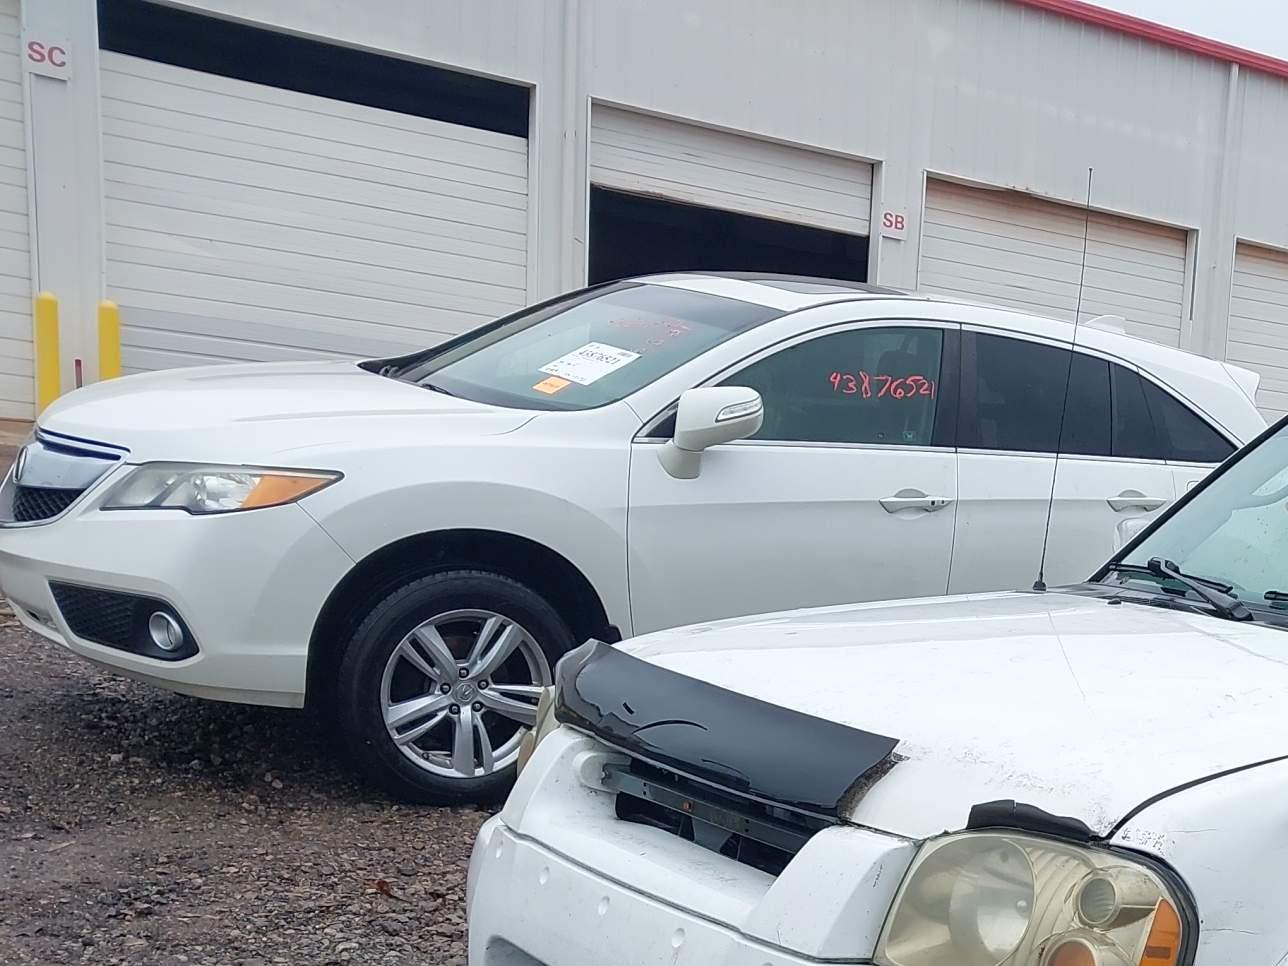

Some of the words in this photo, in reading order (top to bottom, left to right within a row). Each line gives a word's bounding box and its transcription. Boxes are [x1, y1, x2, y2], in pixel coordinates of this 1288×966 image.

[27, 41, 66, 67] SC
[882, 212, 905, 230] SB
[829, 370, 936, 399] 43876521
